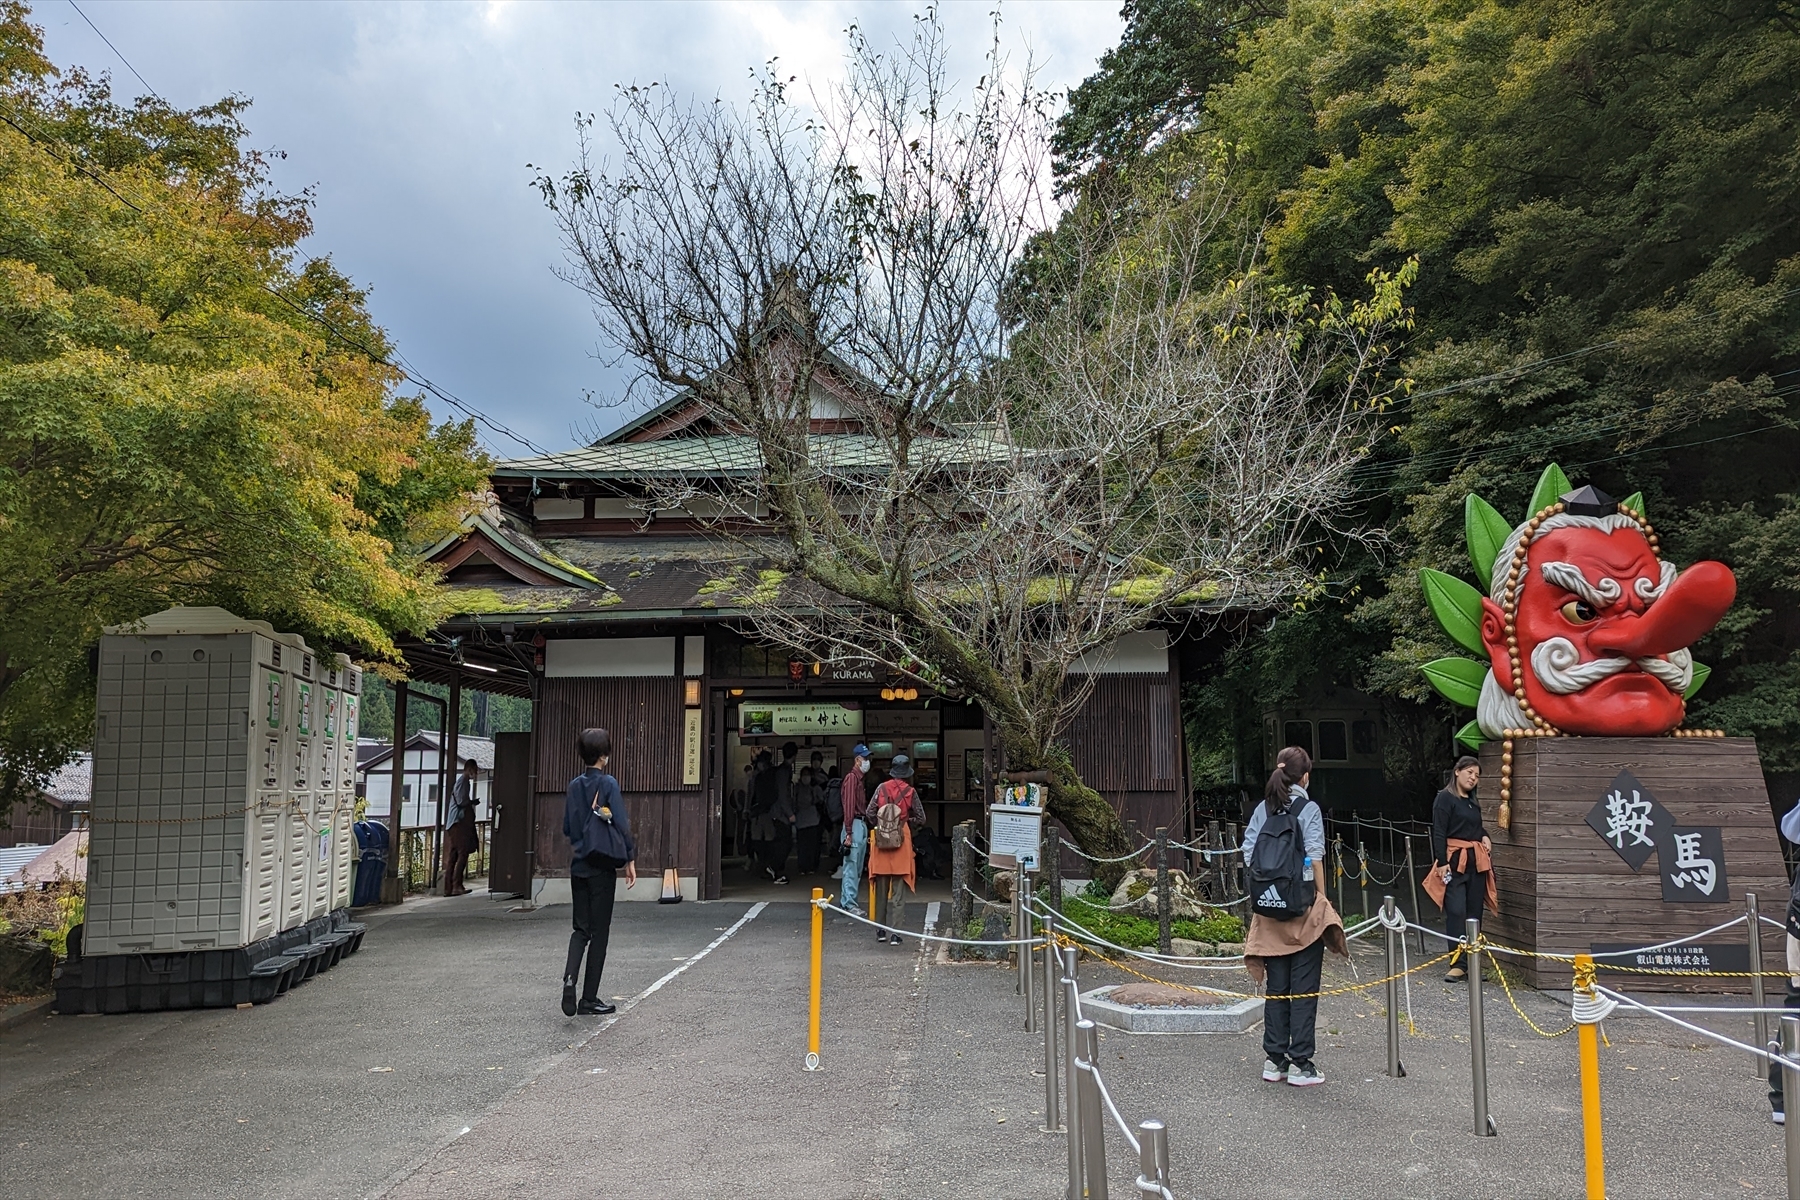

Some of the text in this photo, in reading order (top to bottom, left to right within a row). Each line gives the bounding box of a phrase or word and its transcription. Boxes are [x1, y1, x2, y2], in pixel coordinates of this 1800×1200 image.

[832, 670, 874, 680] KURAMA
[1257, 899, 1287, 908] adidas
[1636, 954, 1710, 965] 叡山電鉄株式会社
